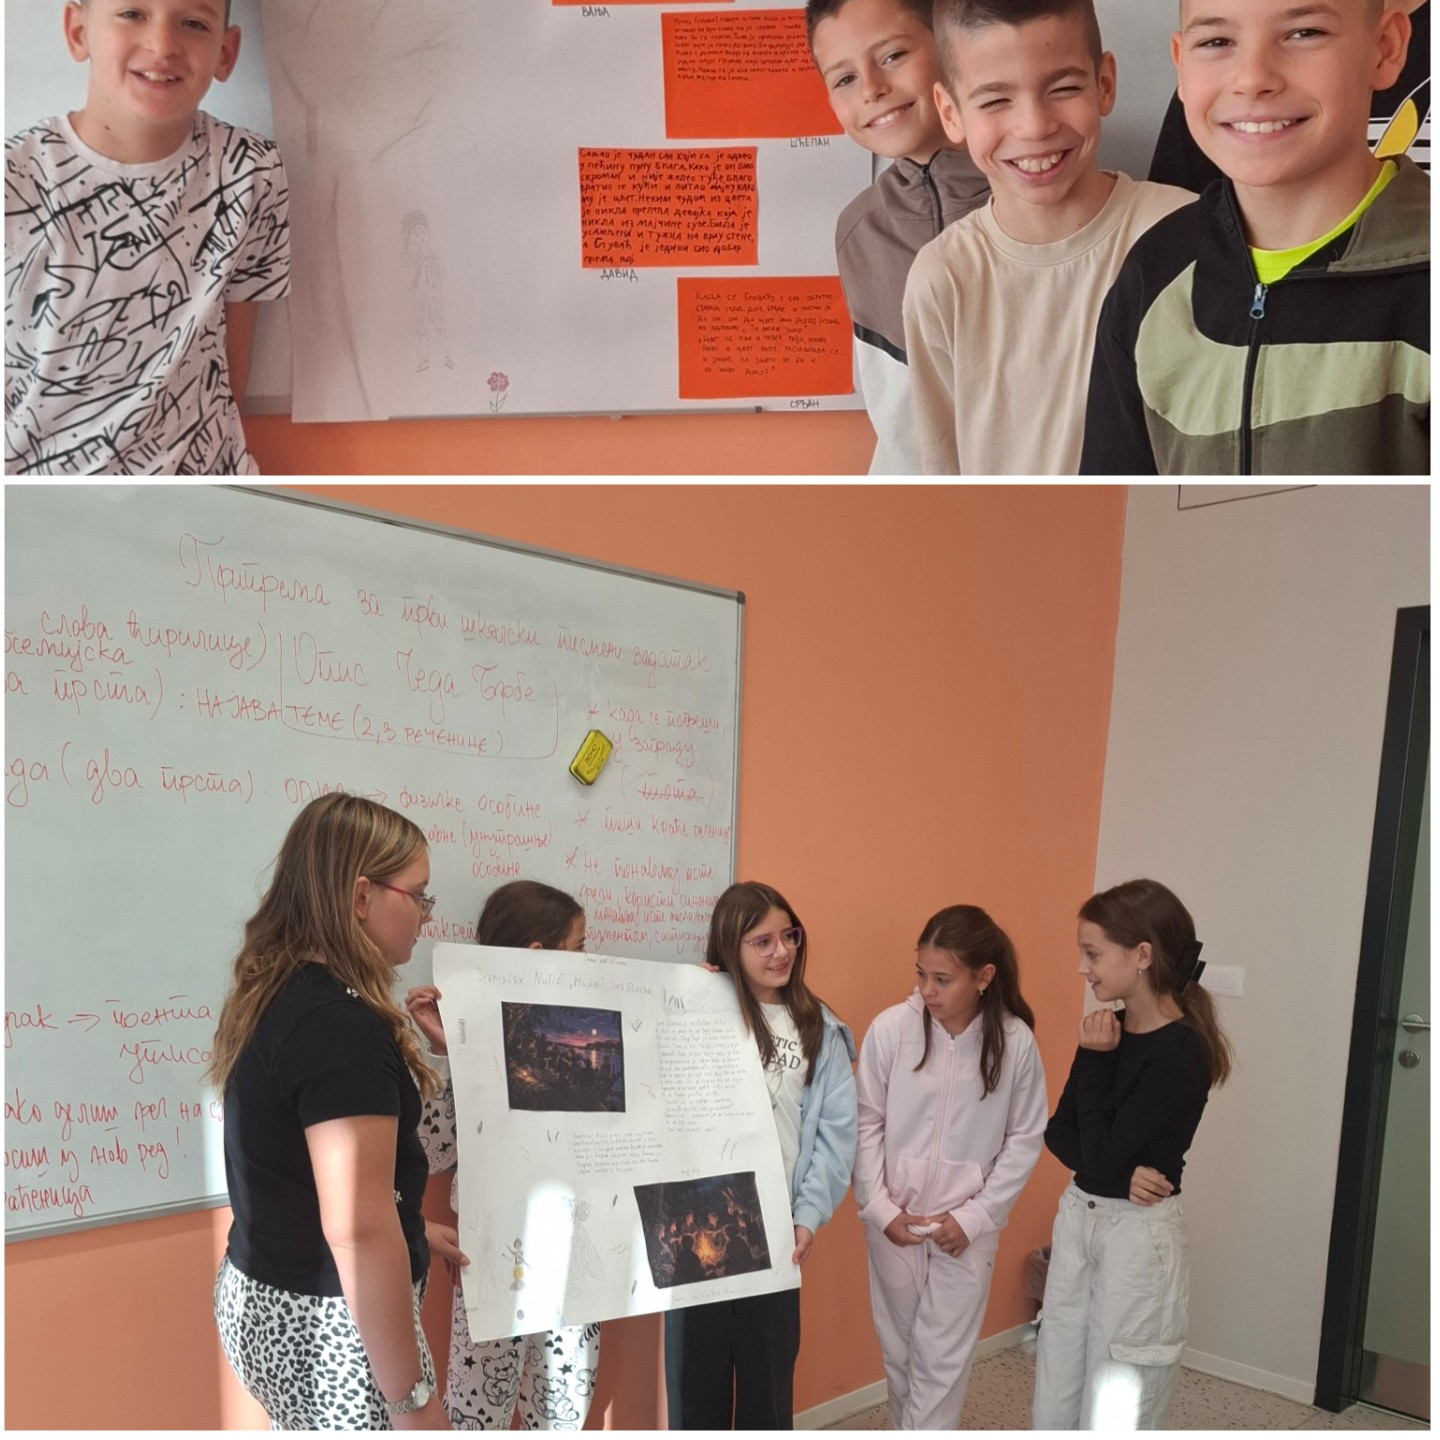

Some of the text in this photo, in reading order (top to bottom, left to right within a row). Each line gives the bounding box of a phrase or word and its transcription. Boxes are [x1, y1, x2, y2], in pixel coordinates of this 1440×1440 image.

[582, 7, 609, 17] ВАЊА
[600, 269, 638, 281] ДАВИД
[41, 605, 113, 640] слова
[179, 533, 710, 688] Припрема за први школски писмени задатак
[396, 648, 460, 725] Чеда
[472, 664, 535, 716] Брбе
[197, 688, 281, 721] НАЈАВА
[286, 705, 346, 730] ТЕМЕ
[608, 700, 643, 742] када
[650, 713, 660, 726] се
[633, 737, 695, 768] заграду
[478, 794, 541, 819] особине
[652, 814, 688, 838] краће
[473, 856, 520, 879] особине
[105, 995, 212, 1028] поента
[119, 1040, 212, 1084] утиса
[55, 1101, 119, 1141] делиш
[134, 1097, 168, 1132] реч
[180, 1101, 203, 1122] на
[61, 1148, 79, 1183] у
[91, 1136, 128, 1166] нов
